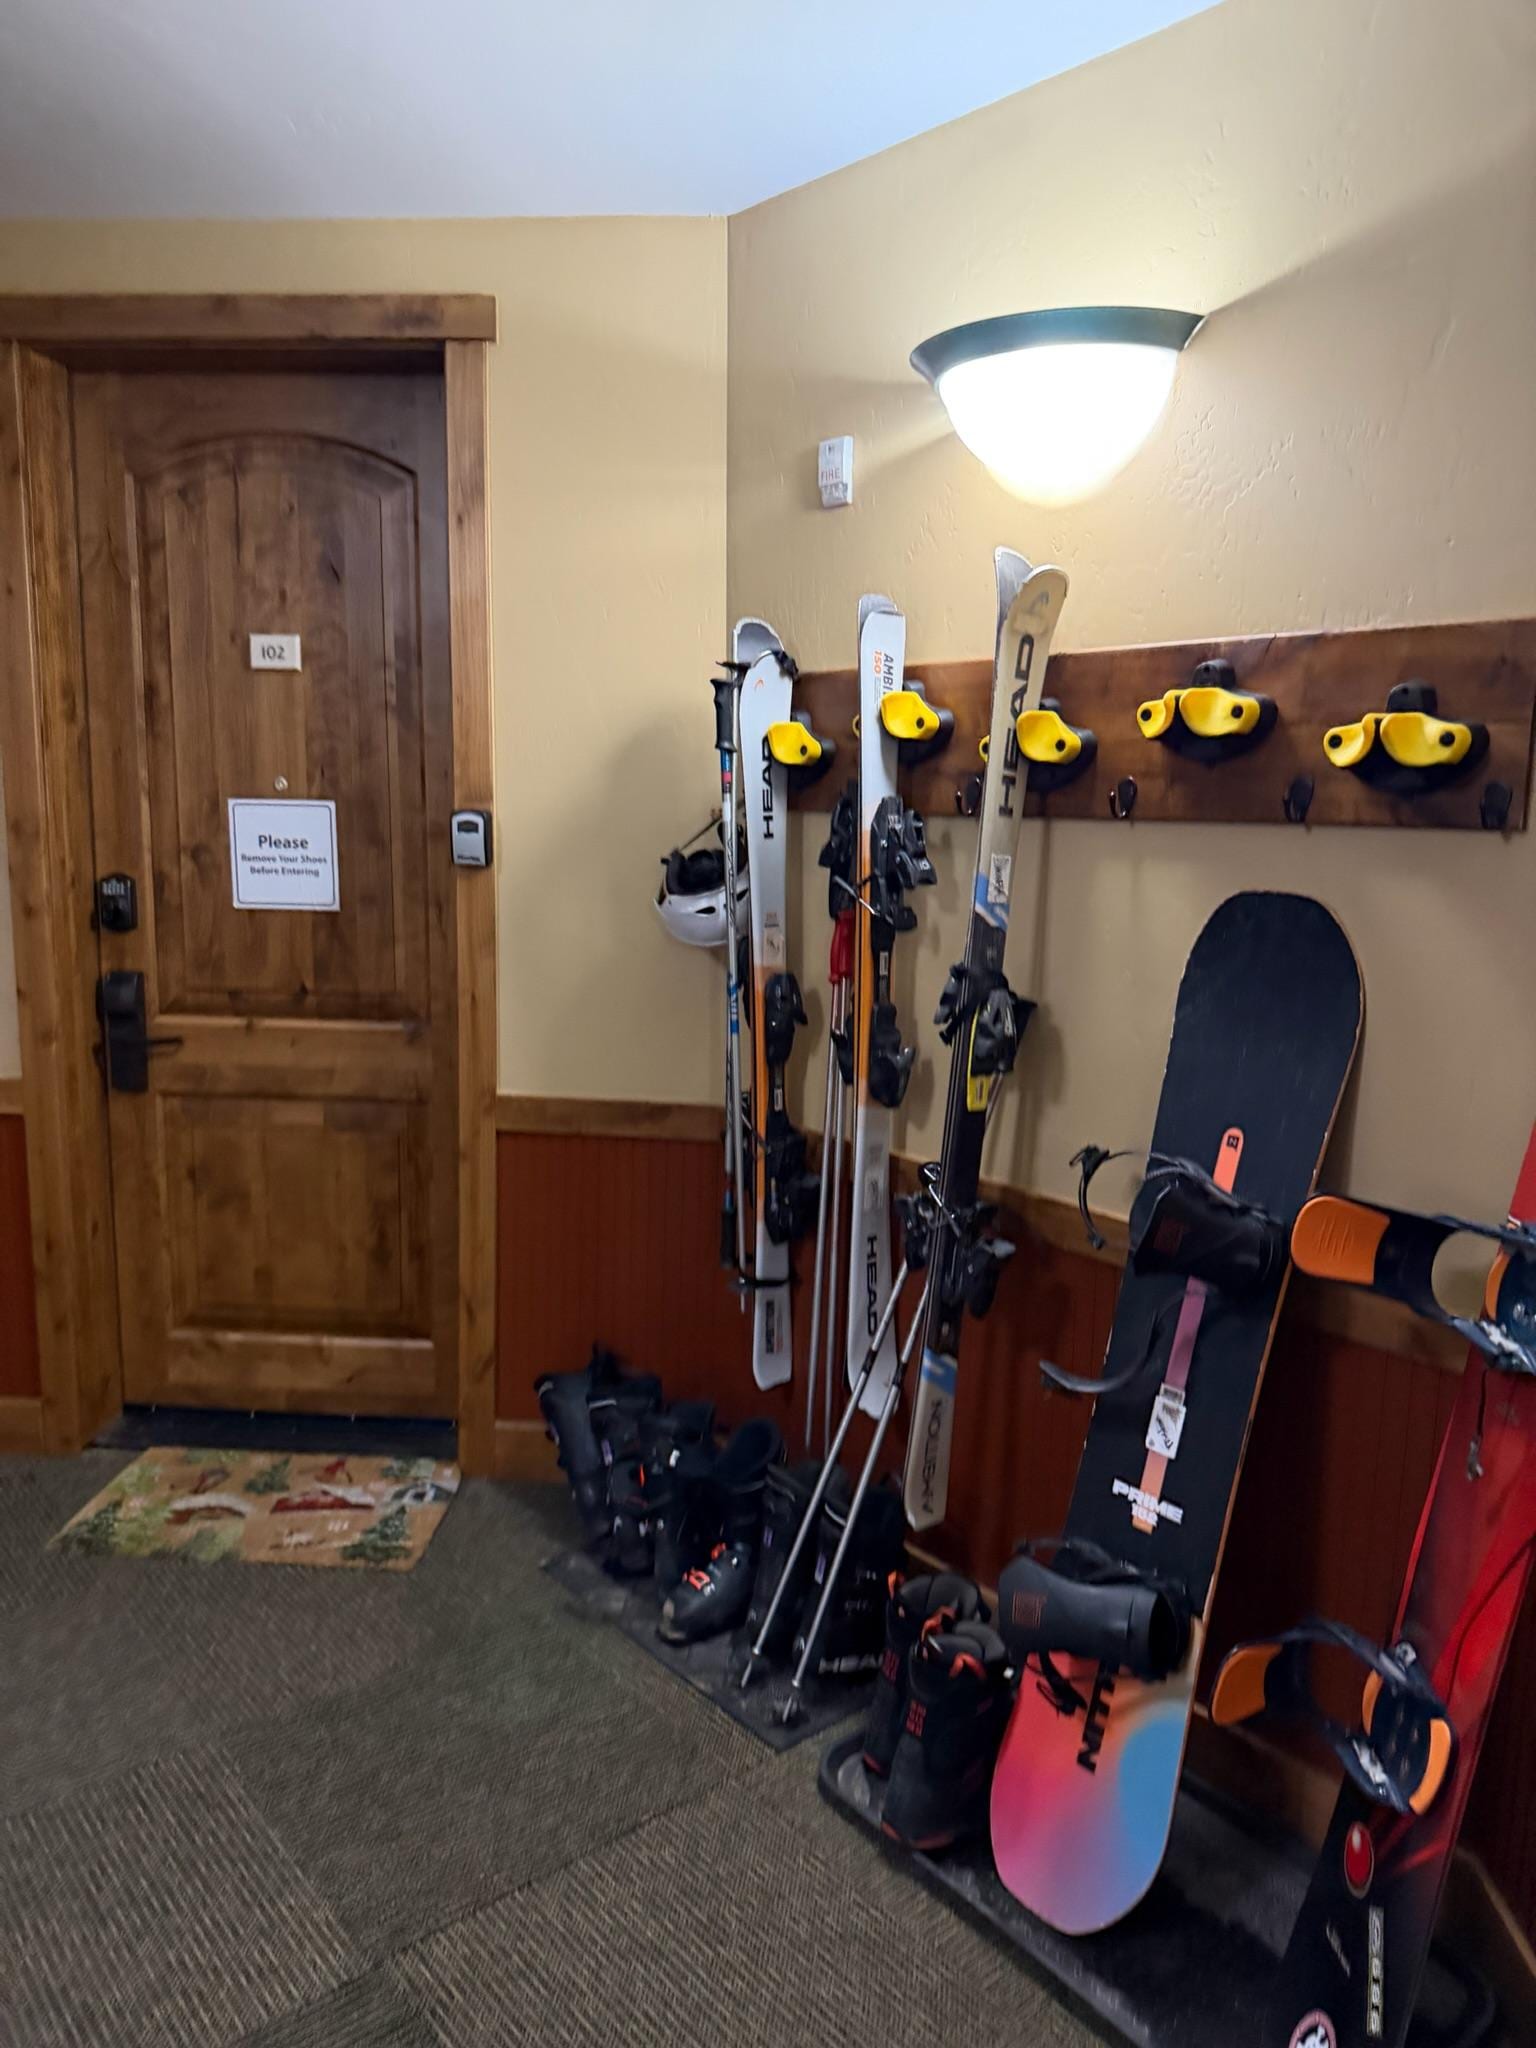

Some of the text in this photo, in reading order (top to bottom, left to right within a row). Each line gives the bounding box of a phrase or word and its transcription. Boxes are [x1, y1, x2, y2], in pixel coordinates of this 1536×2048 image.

[261, 646, 285, 660] 102
[883, 653, 895, 695] AMBI
[999, 633, 1036, 818] HEAD
[258, 835, 309, 849] Please
[241, 854, 327, 864] Remove Your Shoes
[250, 866, 320, 877] Before Entering
[866, 1235, 878, 1338] HEAD
[1112, 1478, 1184, 1525] PRIME
